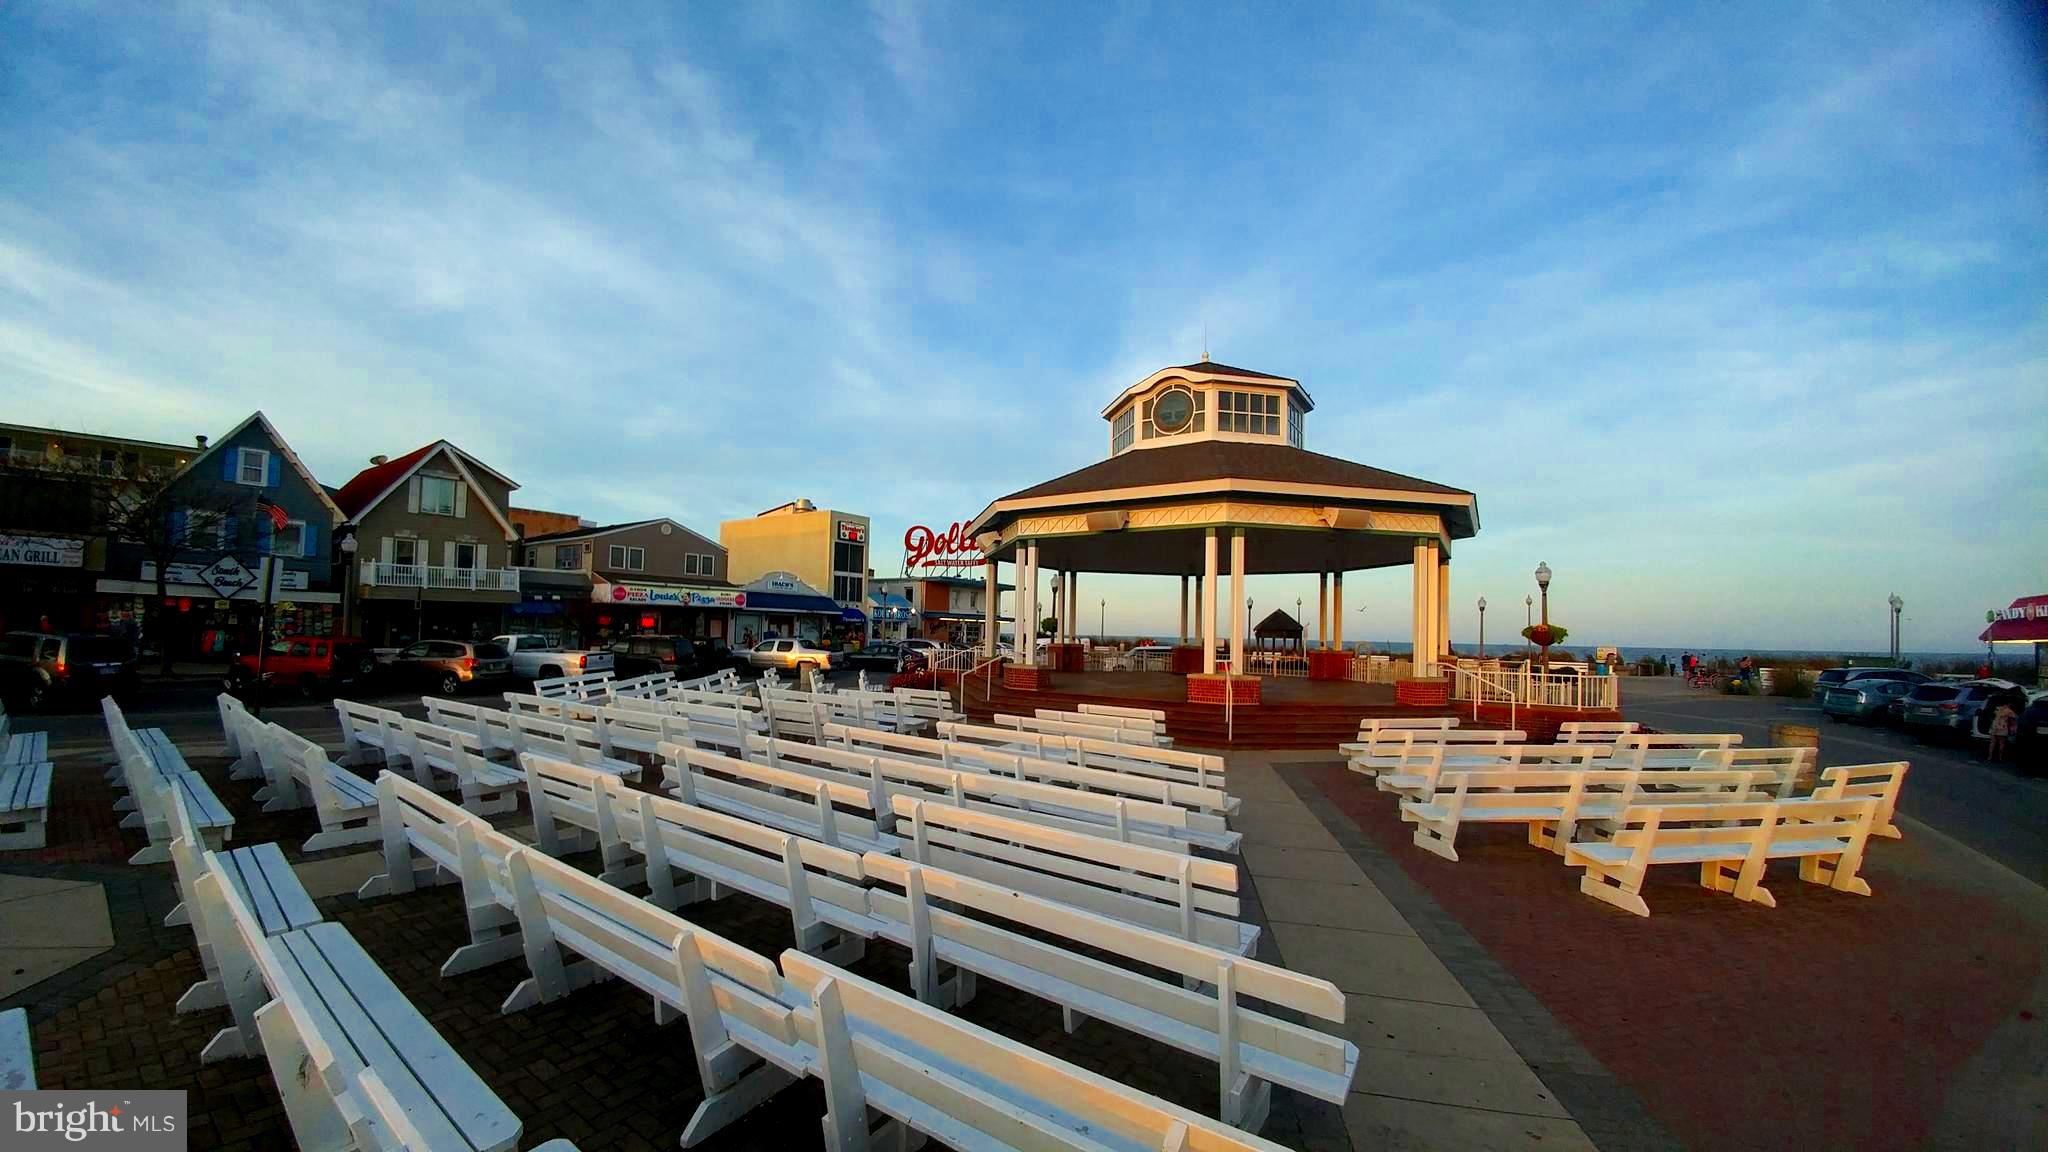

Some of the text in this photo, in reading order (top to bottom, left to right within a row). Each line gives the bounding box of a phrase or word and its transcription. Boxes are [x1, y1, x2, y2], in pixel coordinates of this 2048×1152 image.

[24, 550, 61, 564] GRILL
[934, 559, 979, 567] SALT WATER TAFFY
[212, 564, 240, 576] South
[214, 576, 242, 588] Beach
[649, 589, 678, 602] Louie's
[691, 592, 715, 604] Pizza
